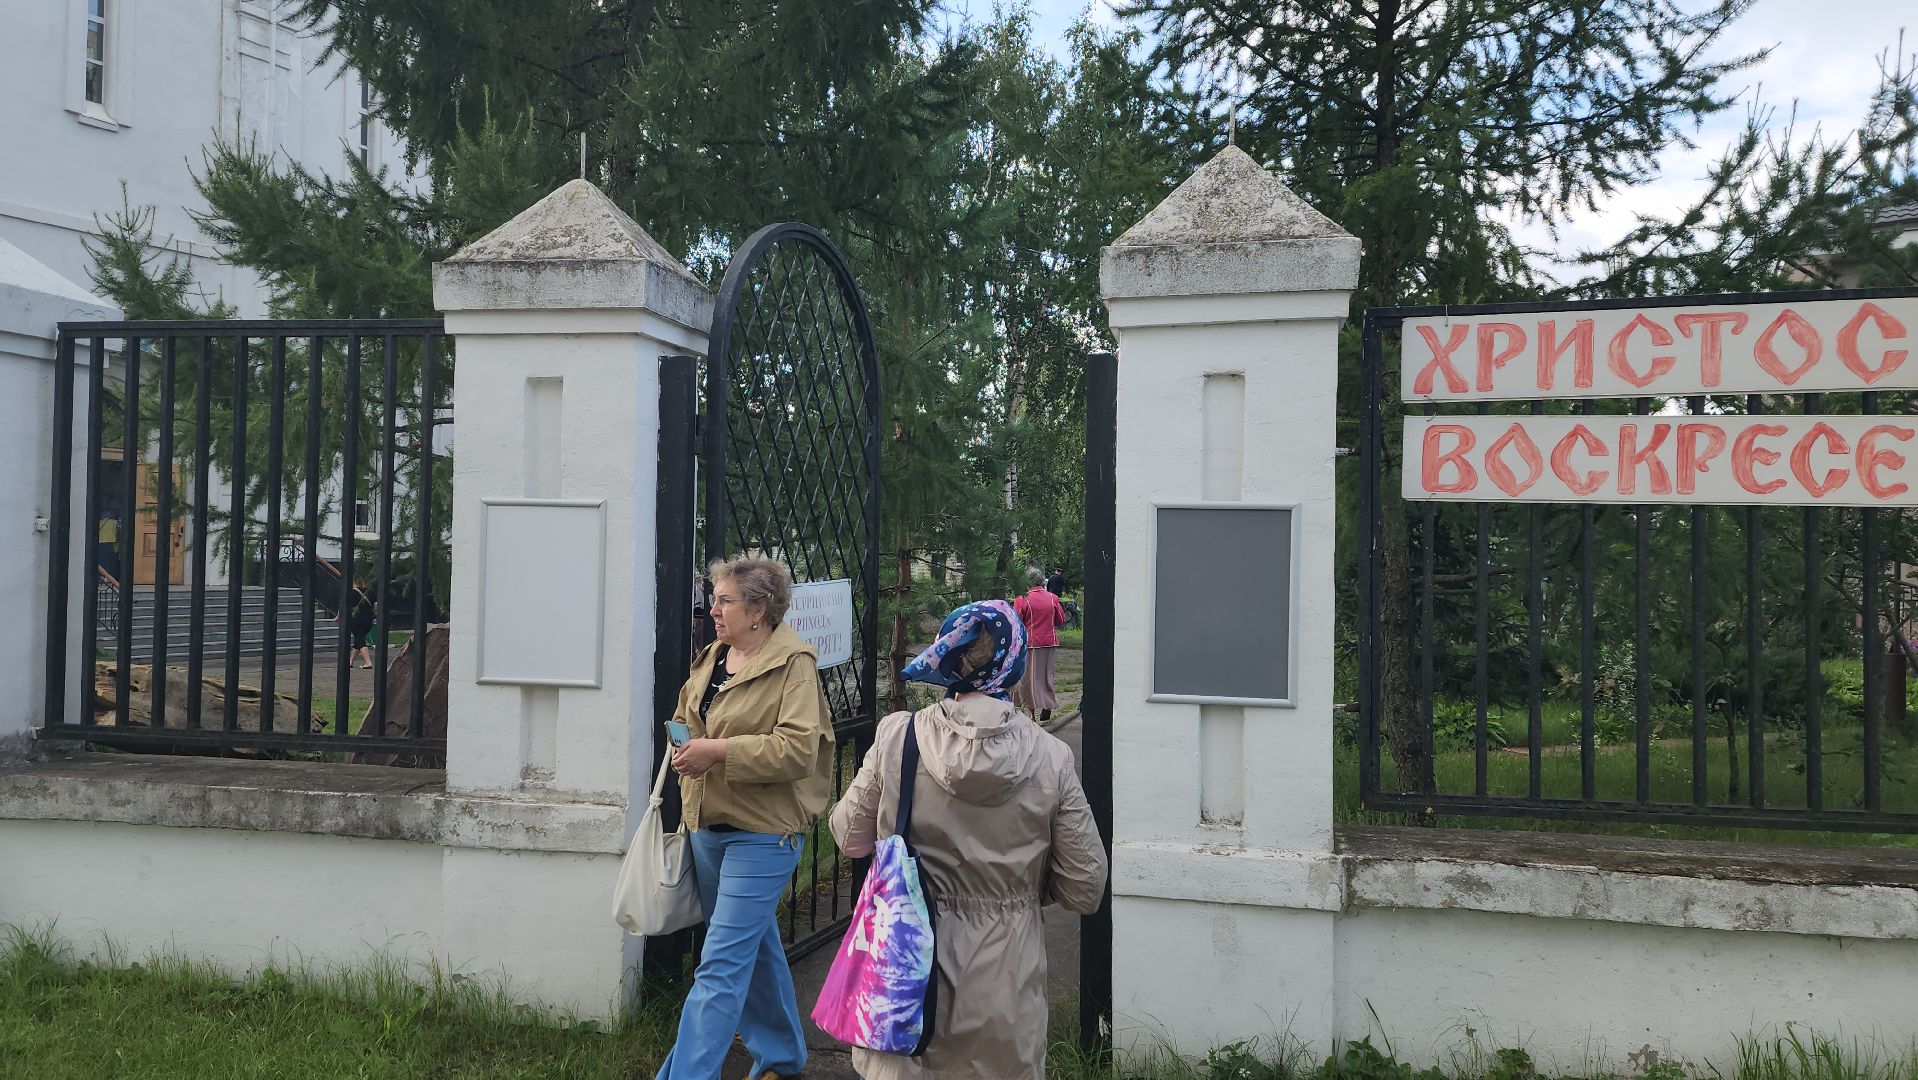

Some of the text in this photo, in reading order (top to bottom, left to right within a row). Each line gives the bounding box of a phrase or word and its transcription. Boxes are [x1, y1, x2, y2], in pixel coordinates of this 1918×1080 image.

[1413, 302, 1909, 395] ХРИСТОС
[1421, 421, 1916, 500] ВОСКРЕСЕ
[790, 614, 832, 632] ПРИХОДА
